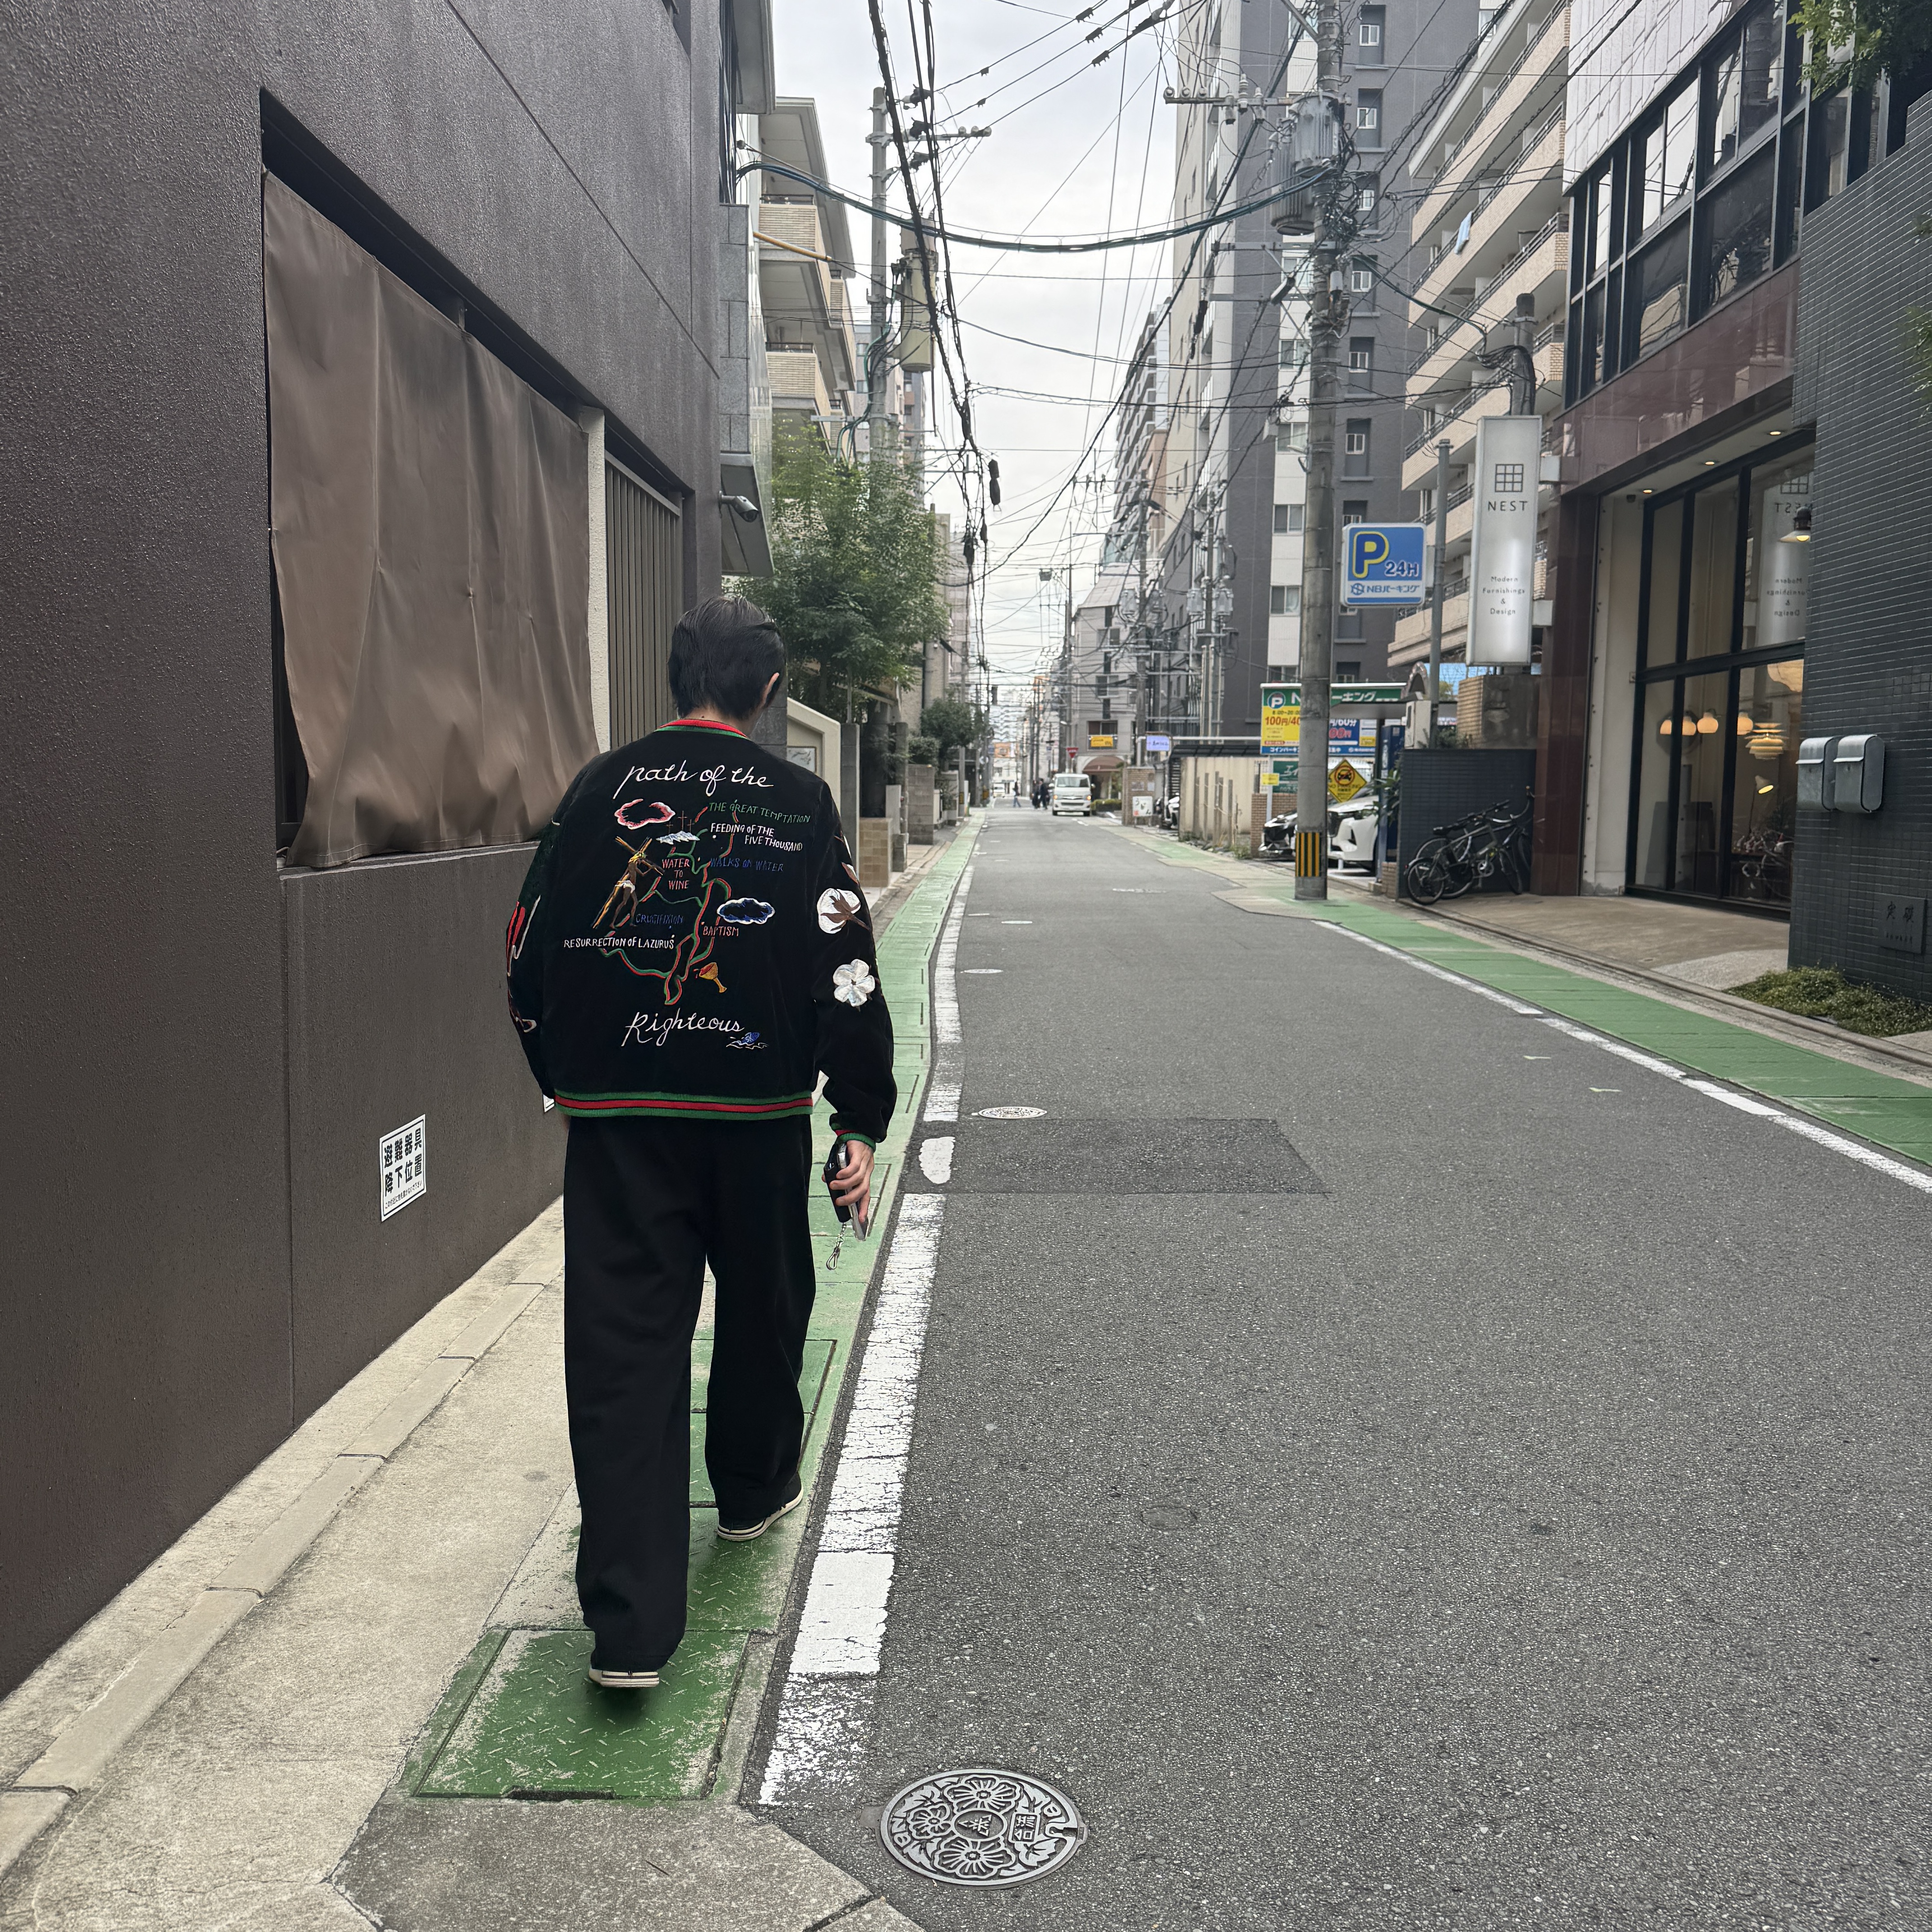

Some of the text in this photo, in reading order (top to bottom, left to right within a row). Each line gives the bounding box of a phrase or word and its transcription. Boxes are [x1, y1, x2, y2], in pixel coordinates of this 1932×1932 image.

[1488, 501, 1528, 511] NEST
[1352, 531, 1389, 578] P
[1384, 560, 1419, 577] 24H
[1490, 607, 1516, 616] Design
[612, 759, 774, 799] path of the
[709, 802, 810, 823] THE GREAT TEMPTATION
[710, 823, 775, 837] FEEDING OF THE
[745, 835, 803, 851] FIVE THOUSAND
[662, 858, 690, 869] WATER
[711, 858, 740, 868] WALKS
[756, 860, 784, 872] WATER
[674, 869, 683, 878] TO
[668, 880, 690, 890] WINE
[703, 926, 739, 937] BAPTISM
[564, 936, 674, 950] RESURRECTION OF LAZURUS
[621, 1007, 745, 1047] Righteous
[384, 1127, 422, 1168] 避難器具
[385, 1153, 422, 1197] 降下位置
